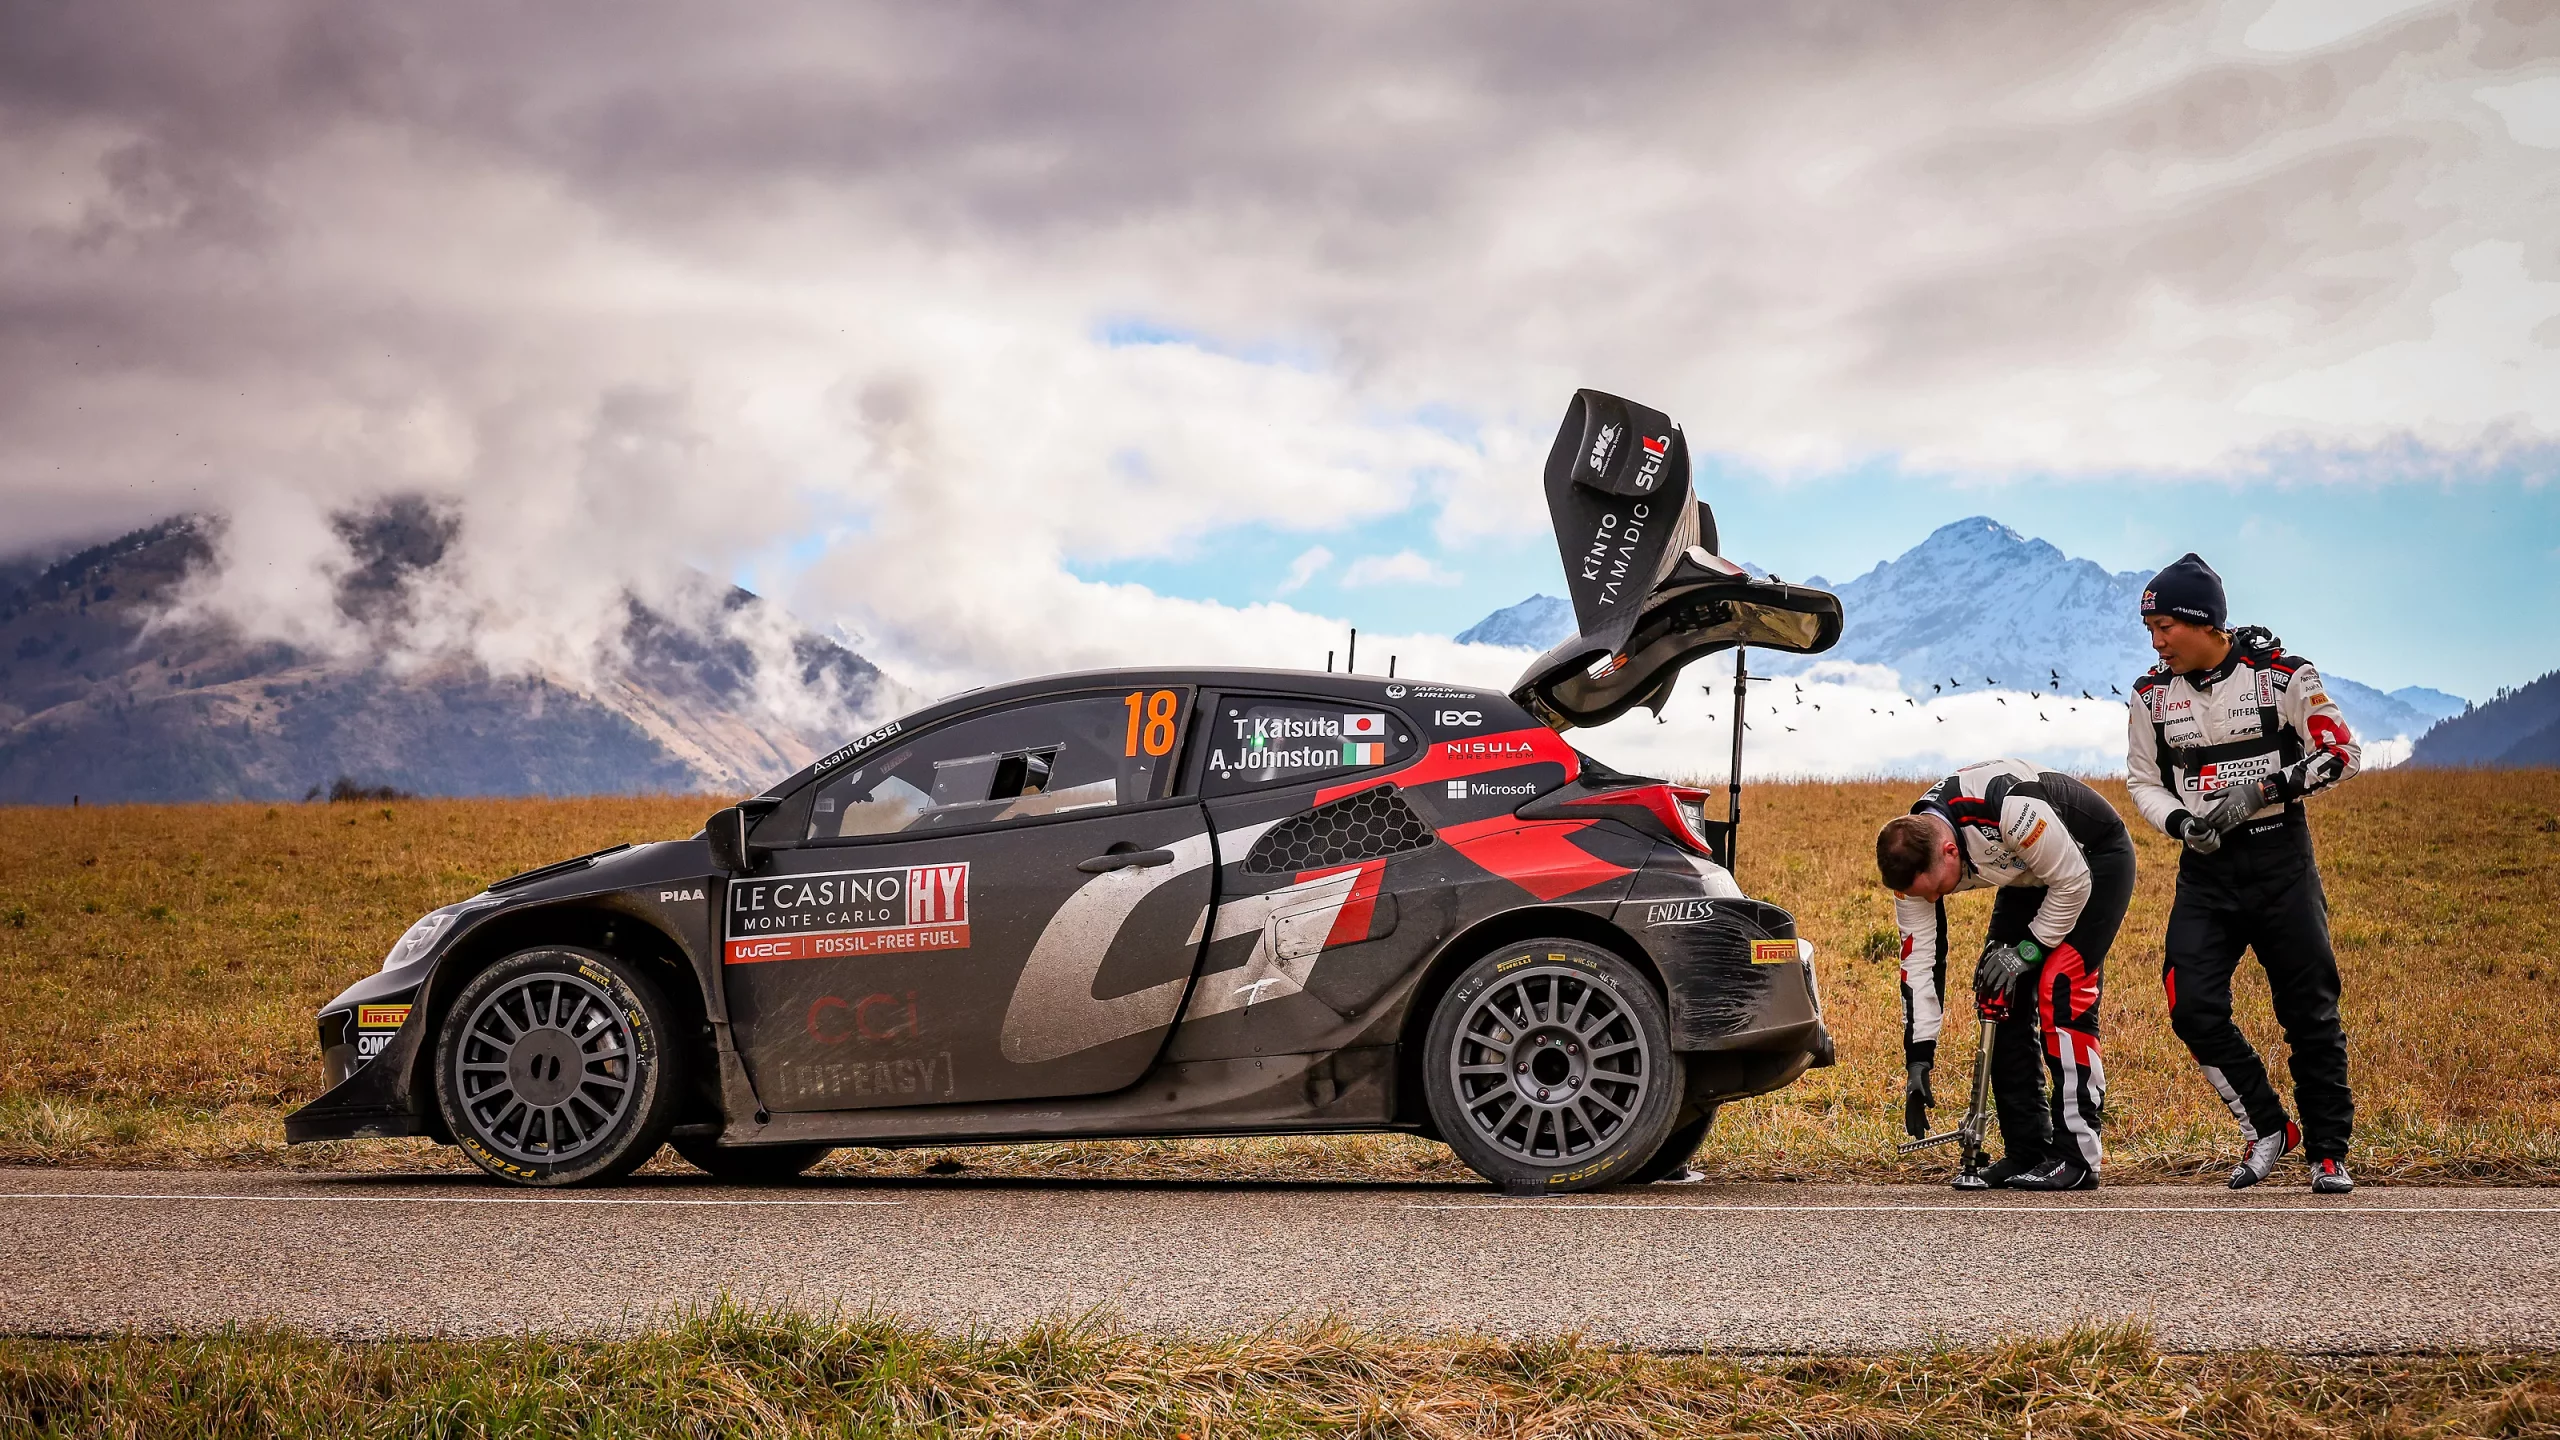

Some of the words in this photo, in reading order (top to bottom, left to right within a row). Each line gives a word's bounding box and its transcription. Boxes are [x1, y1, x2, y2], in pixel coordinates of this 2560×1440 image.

[1590, 423, 1617, 472] SWS
[1598, 503, 1649, 605] TAMADIC
[2260, 674, 2271, 703] SIMPSON
[1124, 689, 1178, 757] 18
[1447, 742, 1533, 754] NISULA
[2217, 768, 2267, 780] GAZOO
[2218, 758, 2271, 771] TOYOTA
[1471, 782, 1537, 795] Microsoft
[2008, 802, 2030, 836] Panasonic
[660, 888, 705, 903] PIAA
[735, 886, 766, 912] LE
[773, 877, 900, 910] CASINO
[911, 867, 963, 923] HY
[744, 913, 811, 931] MONTE
[826, 908, 890, 925] CARLO
[1646, 900, 1715, 923] ENDLESS
[735, 942, 792, 959] WRC
[815, 932, 915, 954] FOSSIL-FREE
[920, 930, 960, 946] FUEL
[1496, 954, 1532, 973] PIRELLI
[362, 1008, 411, 1023] PIRELL
